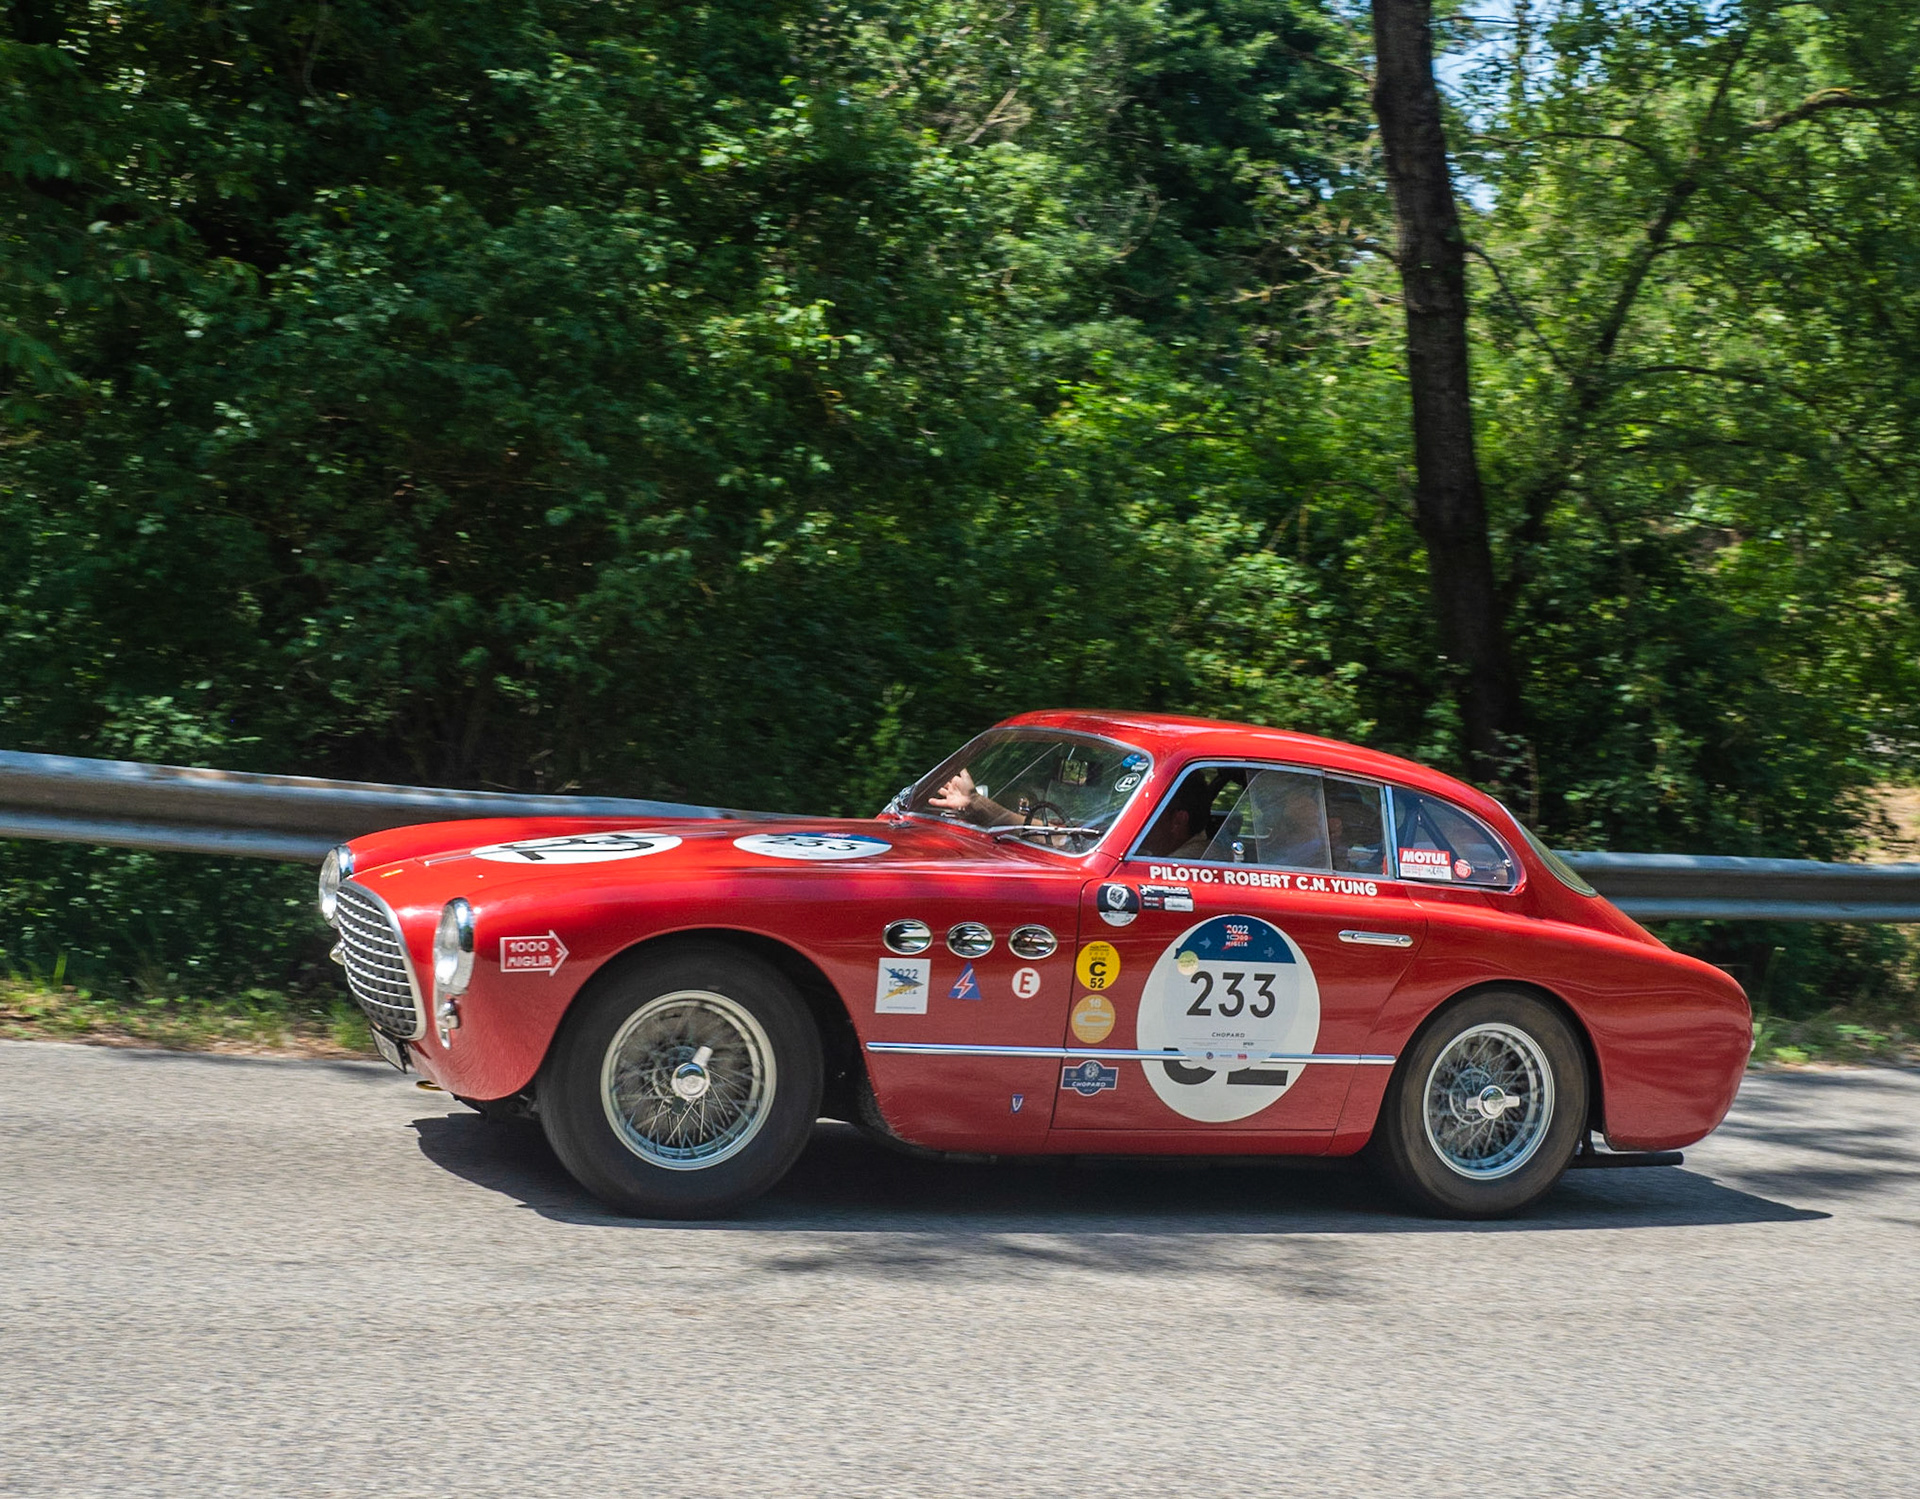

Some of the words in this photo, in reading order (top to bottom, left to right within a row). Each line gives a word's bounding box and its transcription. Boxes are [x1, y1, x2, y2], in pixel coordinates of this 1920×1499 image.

[760, 837, 864, 851] 233
[1402, 850, 1448, 865] MOTUL
[1150, 865, 1219, 884] PILOTO:
[1224, 870, 1291, 889] ROBERT
[1226, 924, 1249, 934] 2022
[509, 941, 550, 953] 1000
[506, 955, 553, 967] MIGLIA
[1089, 961, 1107, 977] C
[1019, 972, 1034, 994] E
[1090, 978, 1105, 989] 52
[1186, 971, 1276, 1019] 233
